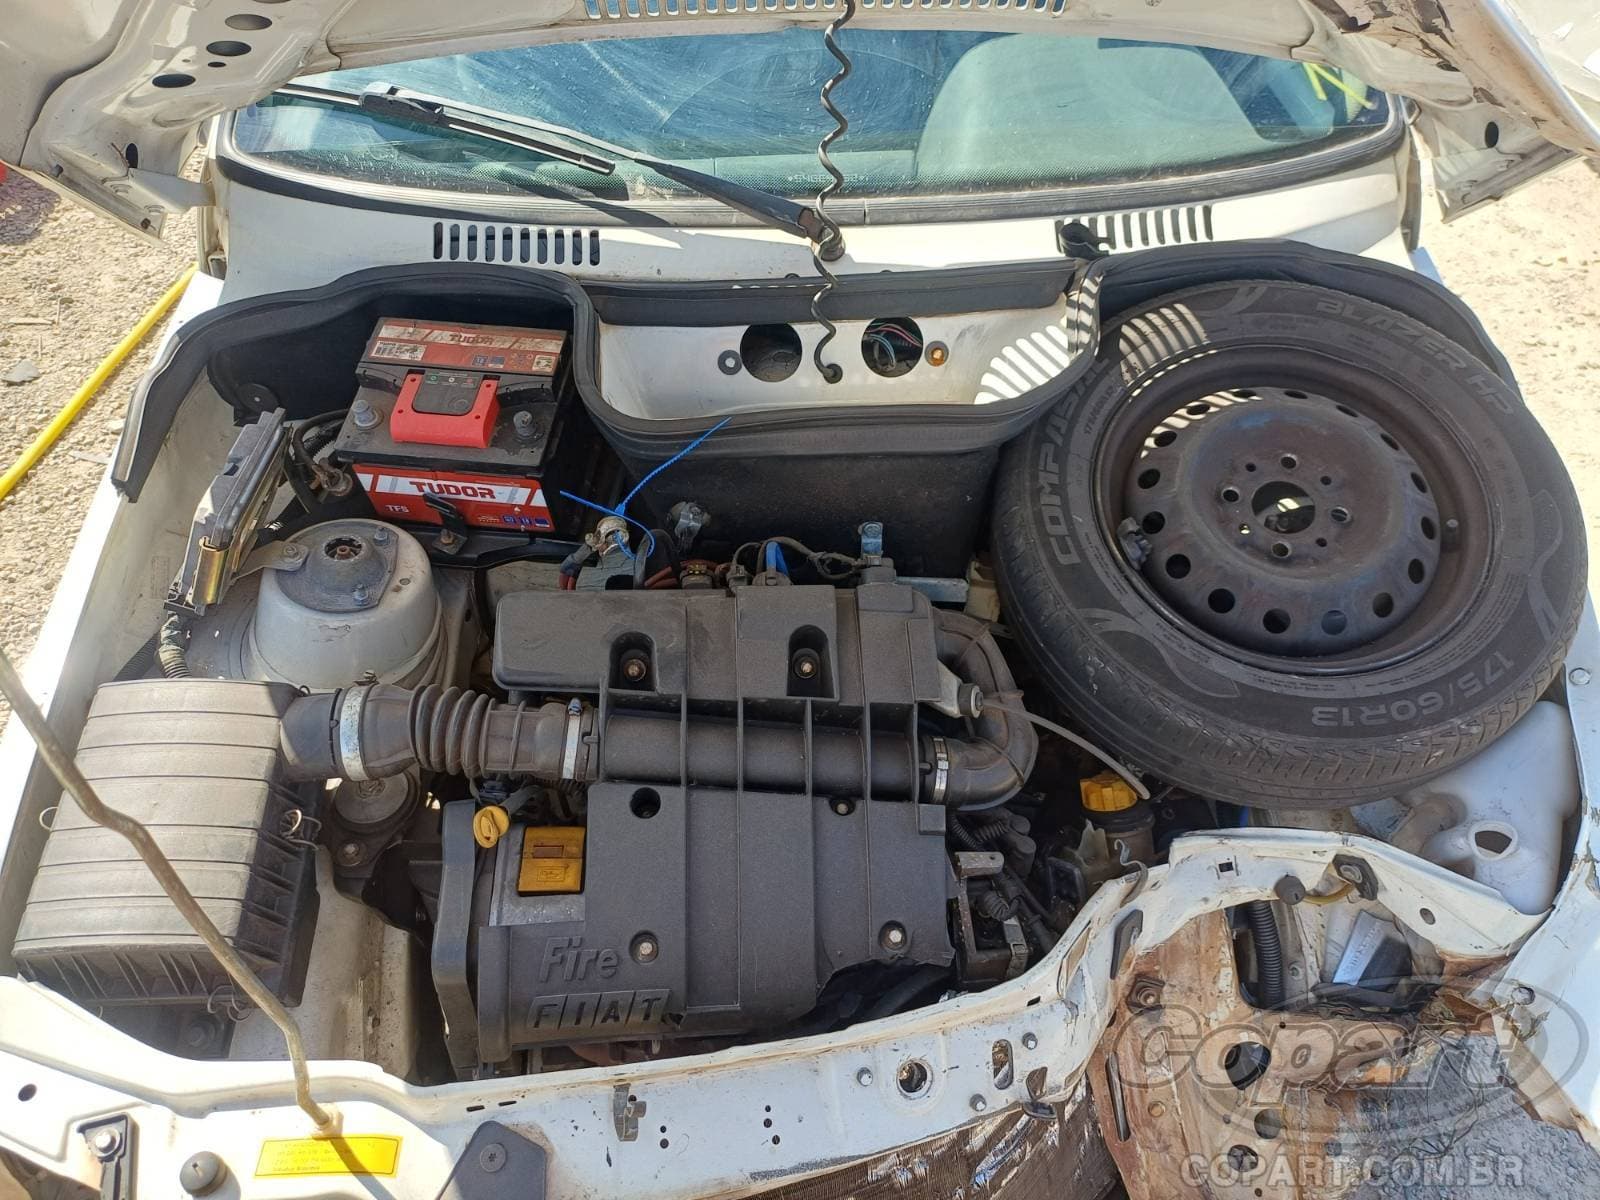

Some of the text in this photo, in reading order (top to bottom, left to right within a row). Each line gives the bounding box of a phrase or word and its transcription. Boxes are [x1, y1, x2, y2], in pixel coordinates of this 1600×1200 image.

[449, 332, 494, 346] TUDOR
[1316, 298, 1515, 415] BLAZER HP
[410, 482, 496, 499] TUDOR
[1311, 651, 1516, 727] 175/60R13
[538, 937, 622, 983] Fire
[533, 998, 660, 1029] FIAT
